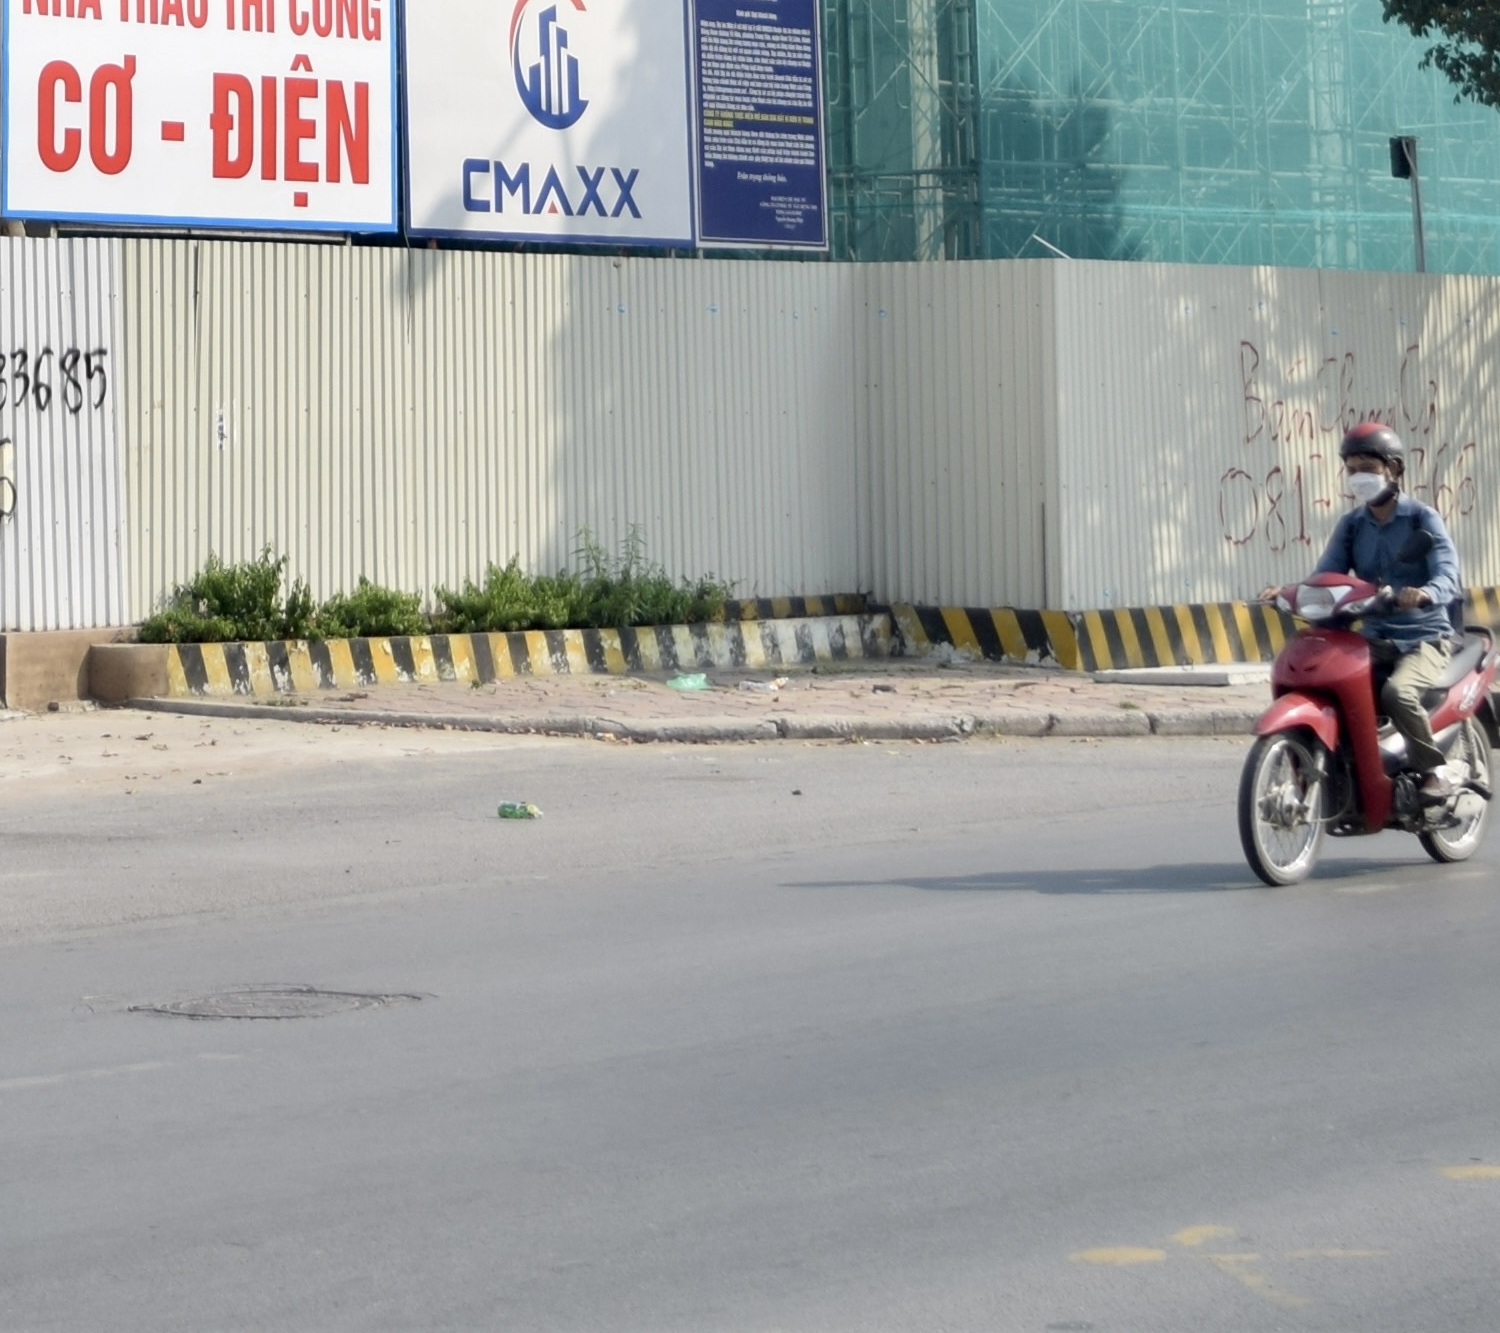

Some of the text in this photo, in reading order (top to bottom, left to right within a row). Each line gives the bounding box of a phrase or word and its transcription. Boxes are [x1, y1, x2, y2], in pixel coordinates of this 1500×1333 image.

[38, 53, 371, 208] CƠ ĐIỆN
[461, 157, 642, 219] CMAXX
